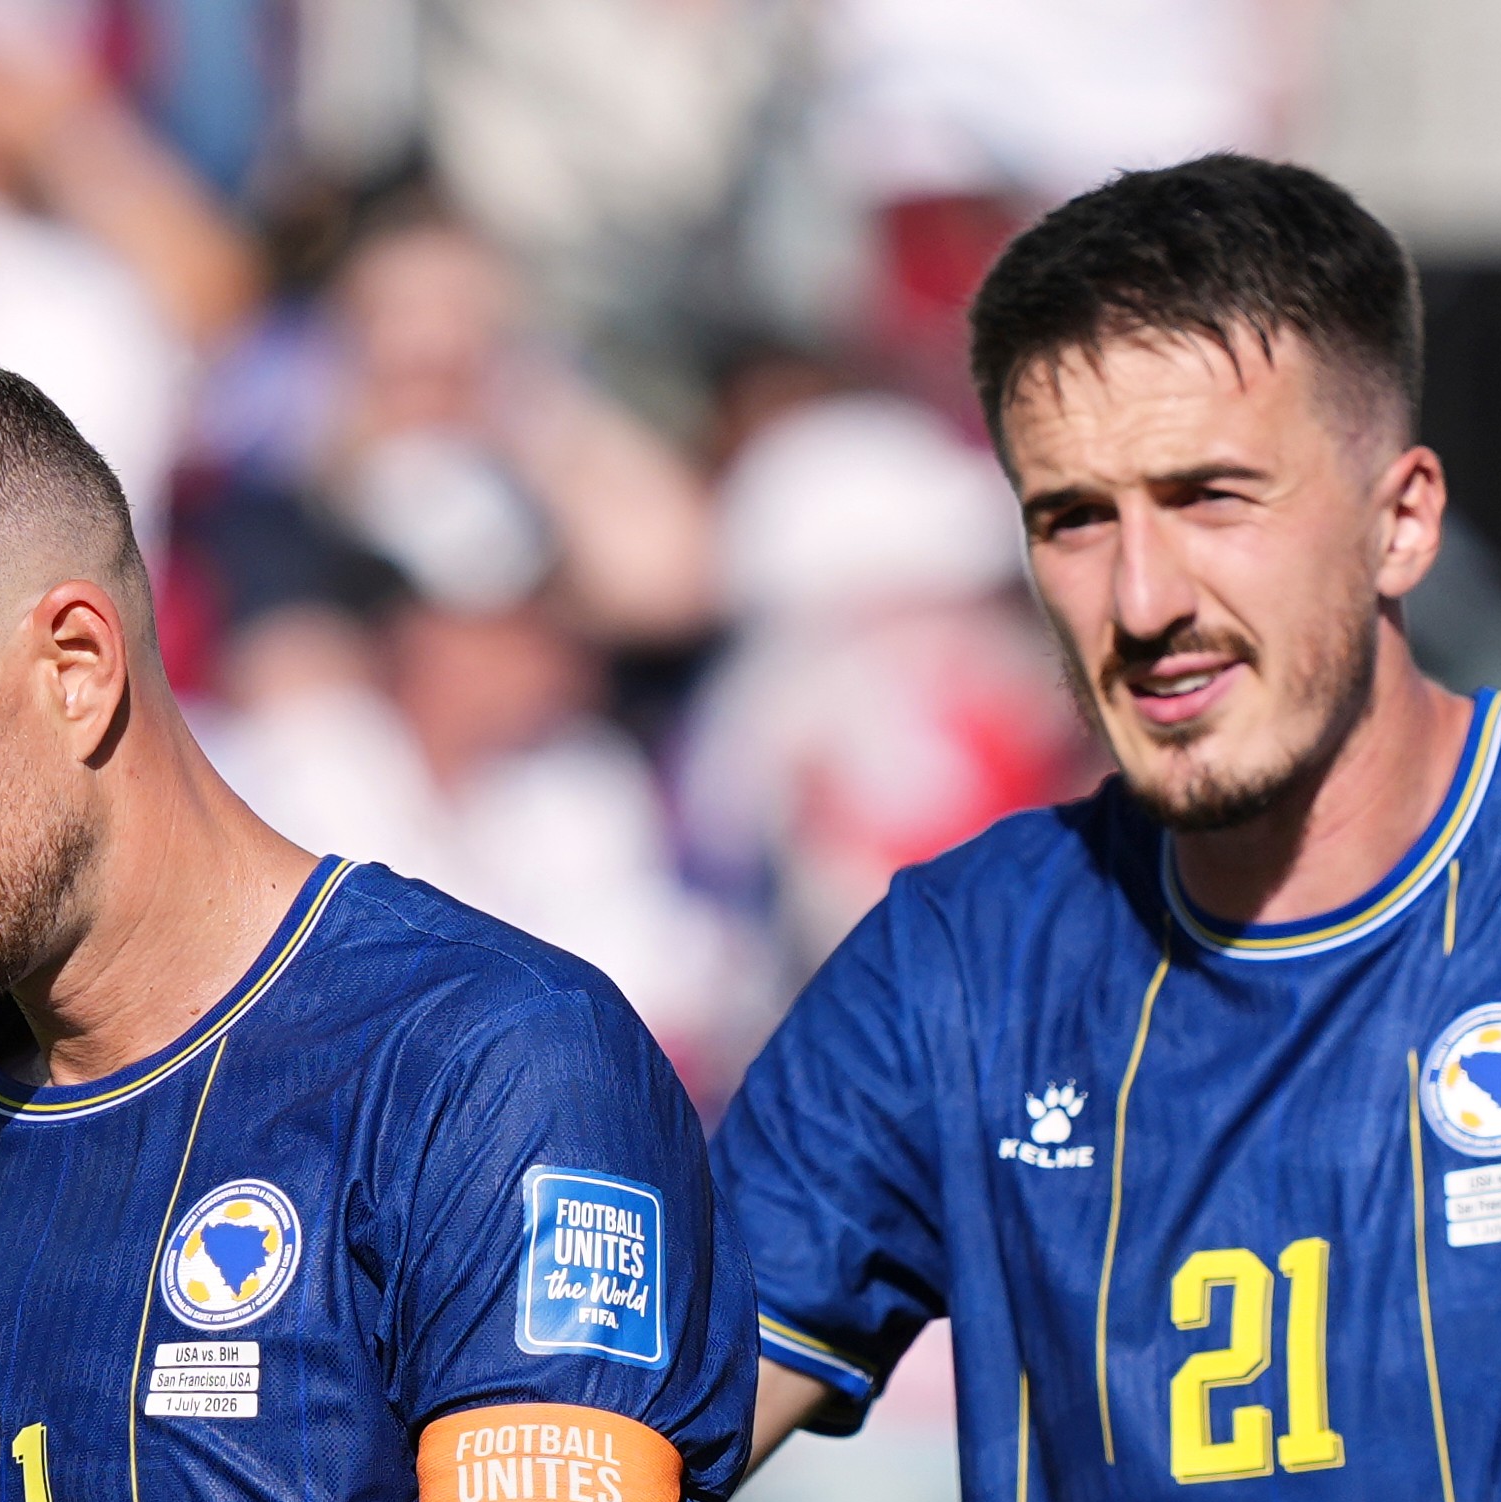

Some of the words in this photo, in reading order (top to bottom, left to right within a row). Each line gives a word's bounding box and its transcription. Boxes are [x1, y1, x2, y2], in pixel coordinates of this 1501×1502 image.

[998, 1137, 1095, 1169] KELME
[556, 1198, 645, 1242] FOOTBALL
[554, 1227, 645, 1279] UNITES
[544, 1267, 586, 1300] the
[590, 1272, 649, 1317] World
[579, 1308, 618, 1329] FIFA
[175, 1347, 198, 1362] USA
[202, 1349, 216, 1362] vs.
[219, 1346, 239, 1361] BIH
[1171, 1237, 1345, 1484] 21
[157, 1373, 176, 1387] San
[178, 1371, 228, 1389] Francisco,
[230, 1372, 251, 1387] USA
[166, 1397, 172, 1411] 1
[175, 1397, 200, 1416] July
[204, 1397, 238, 1412] 2026
[455, 1424, 621, 1466] FOOTBALL
